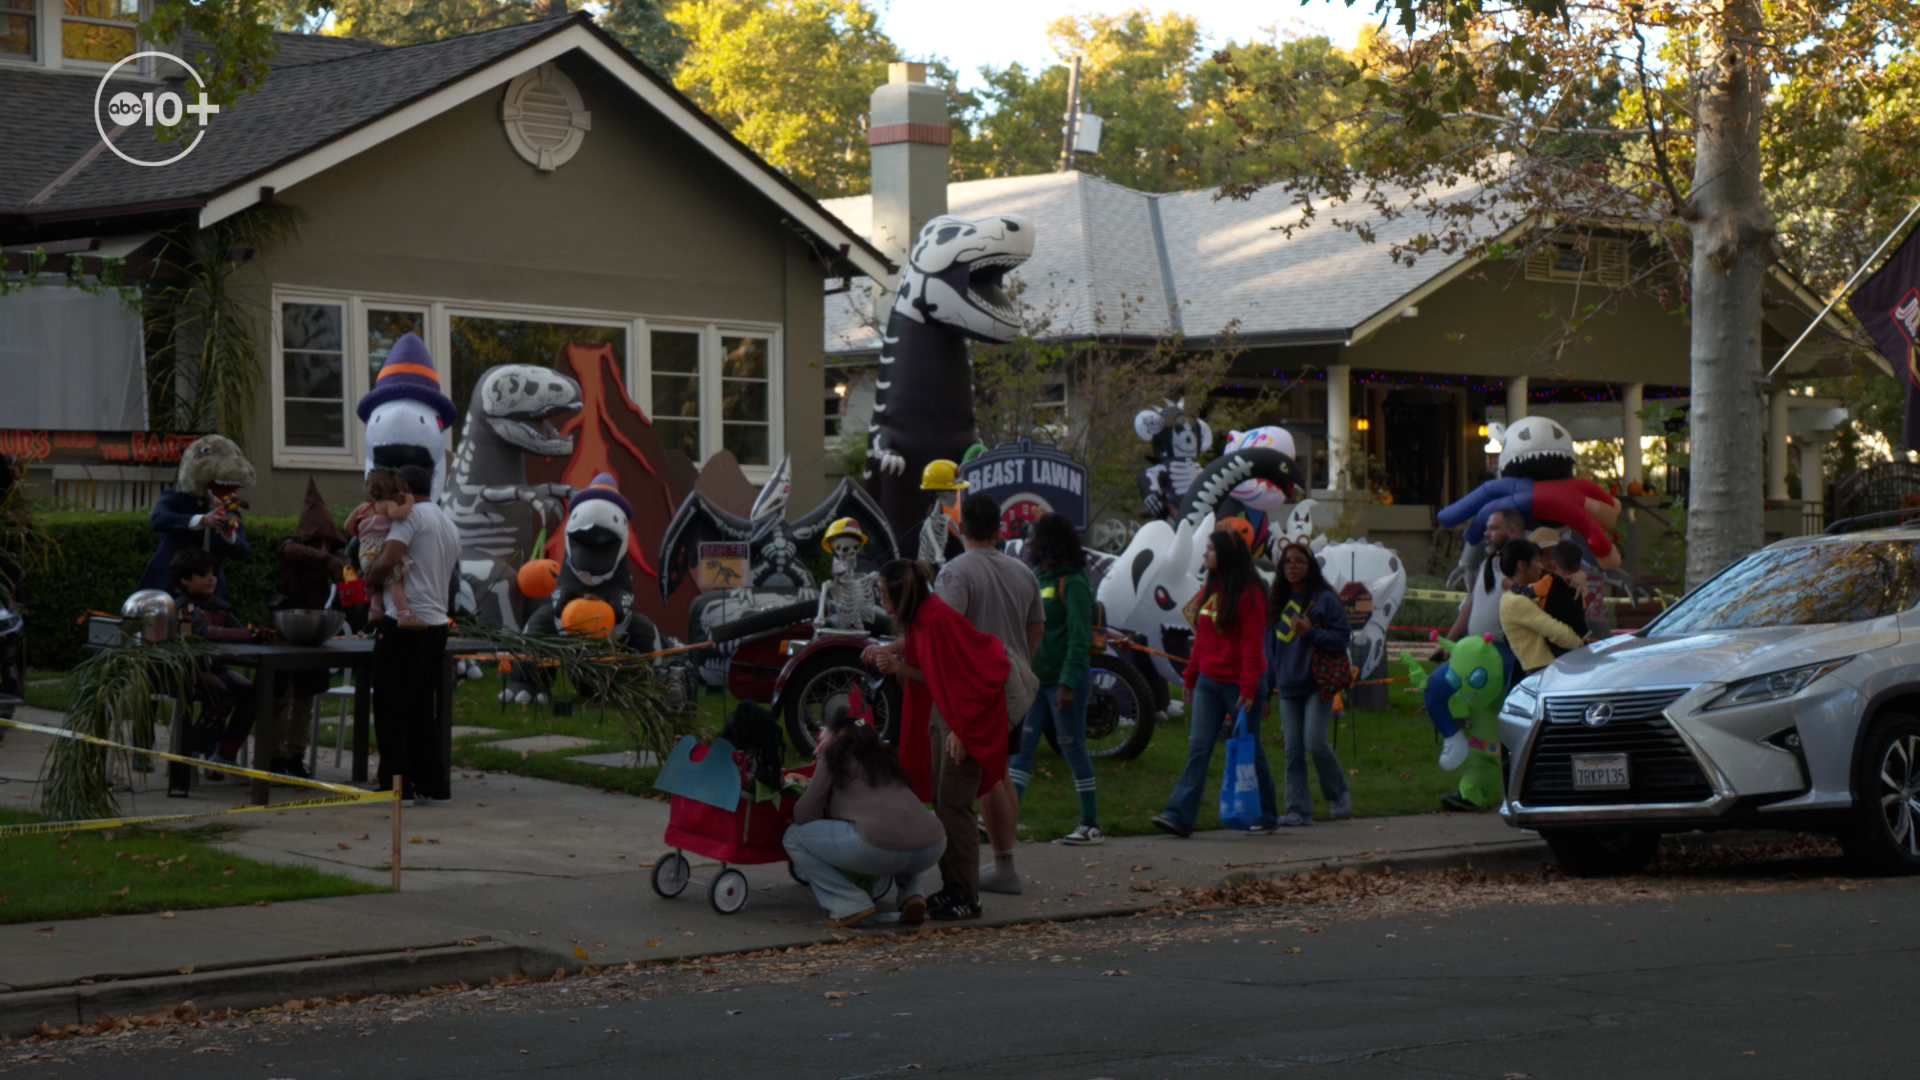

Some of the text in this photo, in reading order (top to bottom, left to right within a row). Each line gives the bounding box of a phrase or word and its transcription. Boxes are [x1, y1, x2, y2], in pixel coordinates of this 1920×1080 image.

[131, 432, 201, 463] EART
[968, 458, 1082, 496] BEAST LAWN
[1576, 768, 1626, 785] 7RKP135
